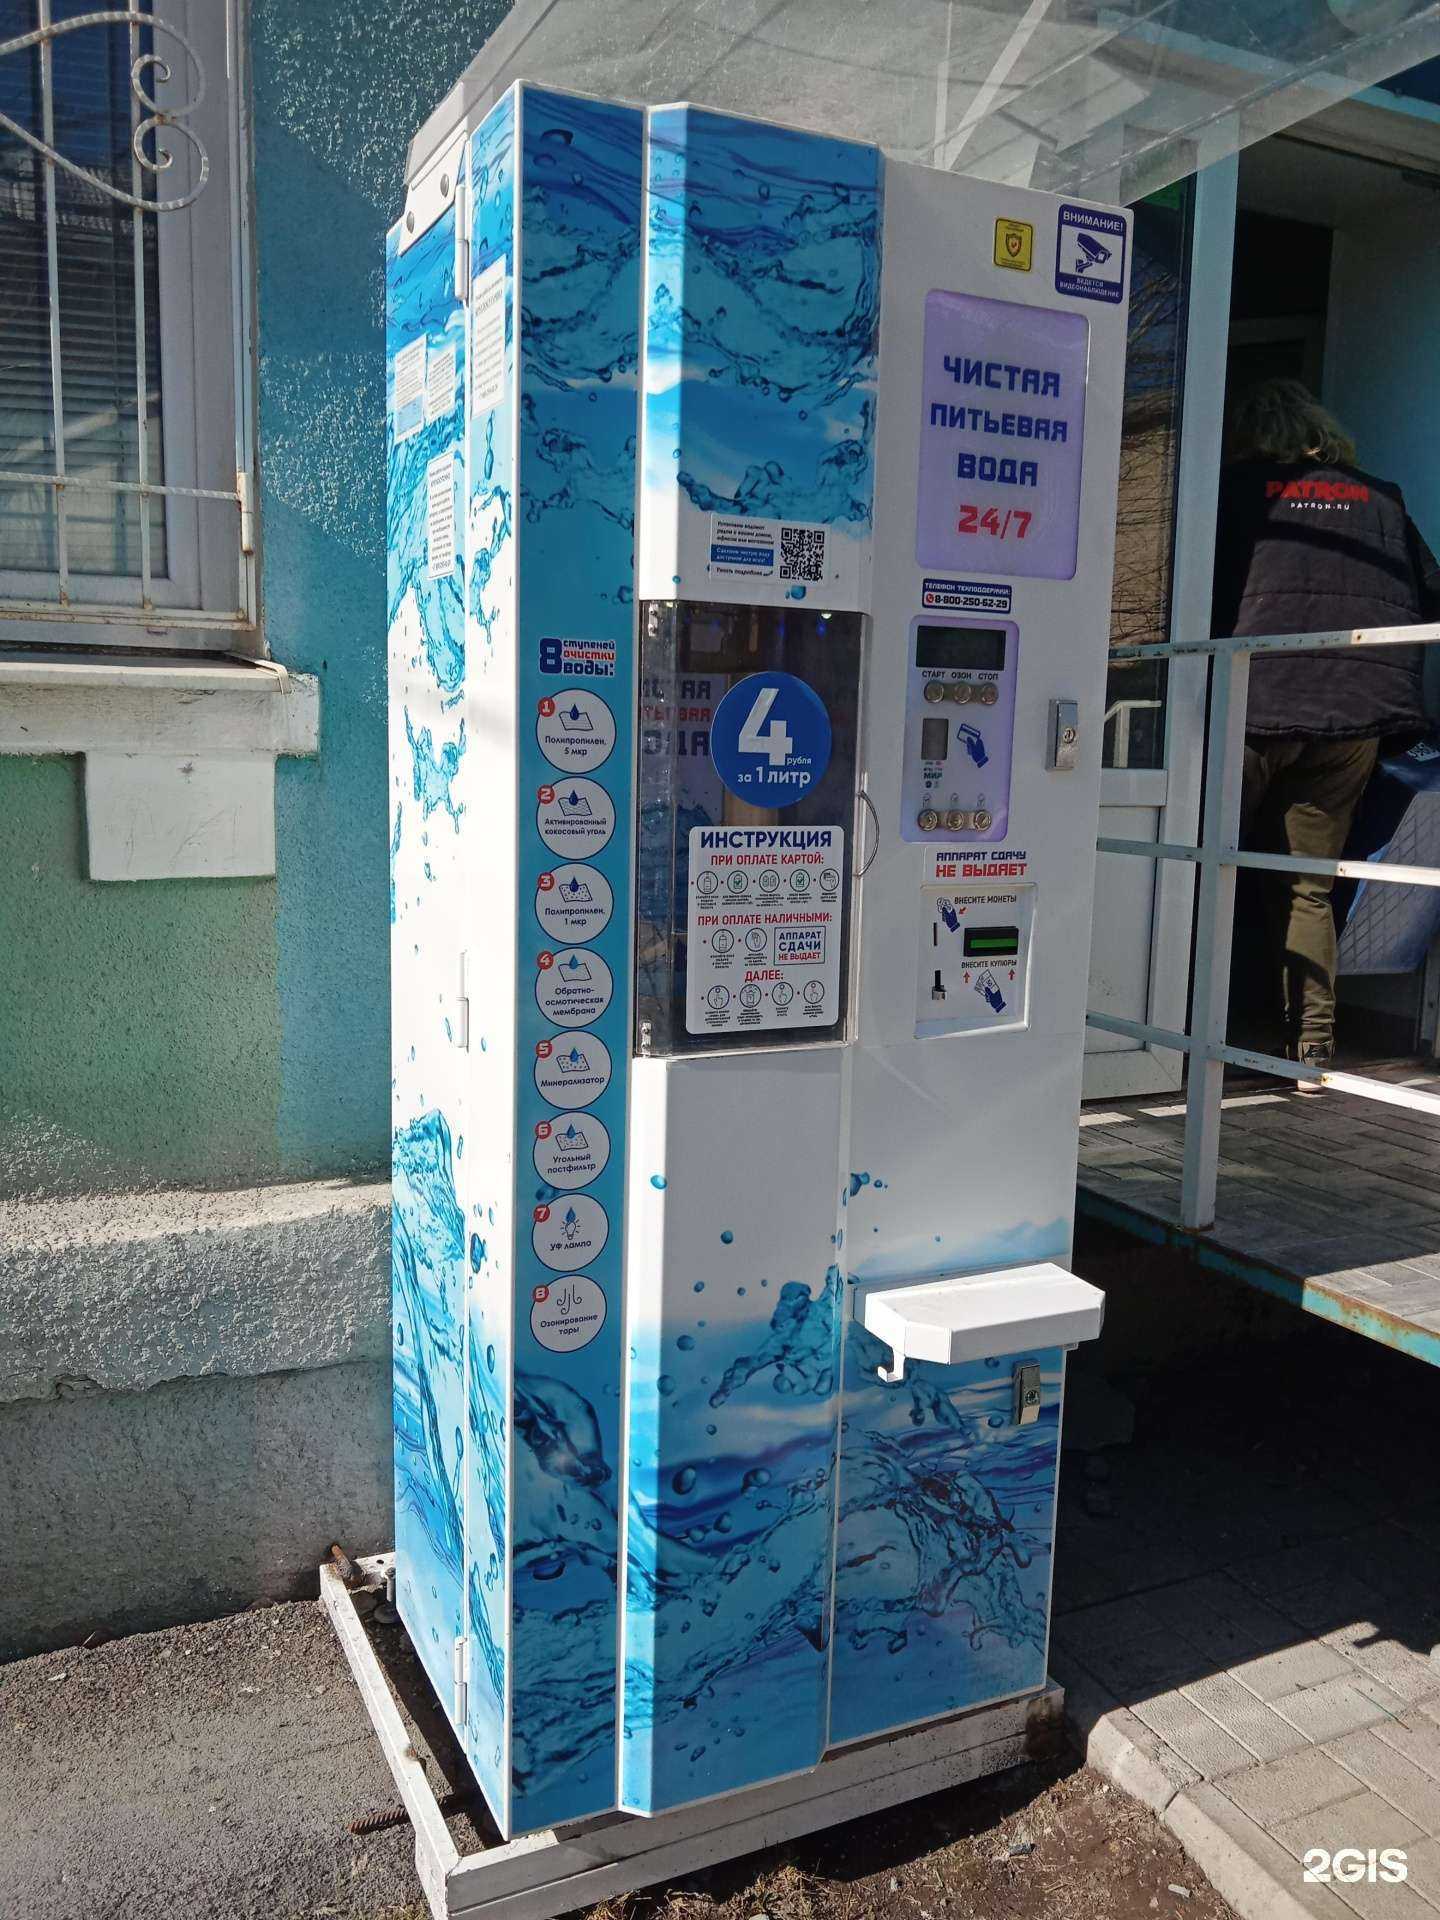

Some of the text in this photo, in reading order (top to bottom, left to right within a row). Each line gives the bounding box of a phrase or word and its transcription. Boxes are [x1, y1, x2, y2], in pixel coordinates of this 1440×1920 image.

[1063, 210, 1123, 232] ВНИМАНИЕ!
[1076, 278, 1104, 287] ВЕДЕТСЯ
[1060, 281, 1120, 298] ВИДЕОНАБЛЮДЕНИЕ
[943, 355, 1061, 398] ЧИСТАЯ
[930, 402, 1068, 443] ПИТЬЕВАЯ
[957, 452, 1039, 488] ВОДА
[1265, 480, 1369, 503] PATRON
[1290, 503, 1350, 511] PATRON.RU
[957, 504, 1033, 539] 24/7
[924, 582, 956, 591] ТЕЛЕФОН
[934, 594, 1008, 609] 8-800-250-62-29
[540, 638, 615, 673] 8 ступеней
[563, 651, 615, 661] очистки
[562, 660, 615, 676] воды:
[922, 671, 946, 679] СТАРТ
[978, 672, 999, 681] СТОП
[542, 701, 551, 713] 1
[737, 687, 793, 766] 4
[545, 735, 607, 747] Полипропилен,
[564, 747, 588, 757] 5 мкр
[786, 756, 812, 766] рубля
[737, 766, 811, 788] за 1 литр
[541, 788, 552, 800] 2
[545, 817, 607, 827] Активированный
[545, 827, 606, 837] кокосовый уголь
[701, 831, 832, 850] ИНСТРУКЦИЯ
[711, 852, 825, 866] ПРИ ОПЛАТЕ КАРТОЙ:
[936, 850, 1027, 862] АППАРАТ СДАЧУ
[935, 863, 1028, 878] НЕ ВЫДАЕТ
[541, 876, 552, 887] 3
[954, 895, 1017, 905] ВНЕСИТЕ МОНЕТЫ
[545, 907, 606, 916] Полипропилен,
[570, 918, 588, 927] мкр
[697, 912, 833, 926] ПРИ ОПЛАТЕ НАЛИЧНЫМИ:
[778, 931, 822, 941] АППАРАТ
[778, 940, 822, 952] СДАЧИ
[540, 955, 551, 967] 4
[778, 953, 789, 961] НЕ
[790, 952, 822, 961] ВЫДАЕТ
[961, 959, 1017, 969] ВНЕСИТЕ КУПЮРЫ
[745, 971, 784, 982] ДАЛЕЕ:
[554, 987, 595, 996] Обратно-
[545, 997, 604, 1006] осмотическая
[552, 1007, 596, 1016] мембрана
[539, 1043, 550, 1055] 5
[540, 1076, 605, 1088] Минерализатор
[538, 1124, 548, 1136] 6
[553, 1153, 591, 1164] Угольный
[548, 1163, 596, 1174] постфильтр
[537, 1208, 547, 1219] 7
[550, 1239, 592, 1251] УФ лампа
[536, 1288, 546, 1299] 8
[540, 1313, 598, 1328] Озонирование
[559, 1327, 580, 1337] тары
